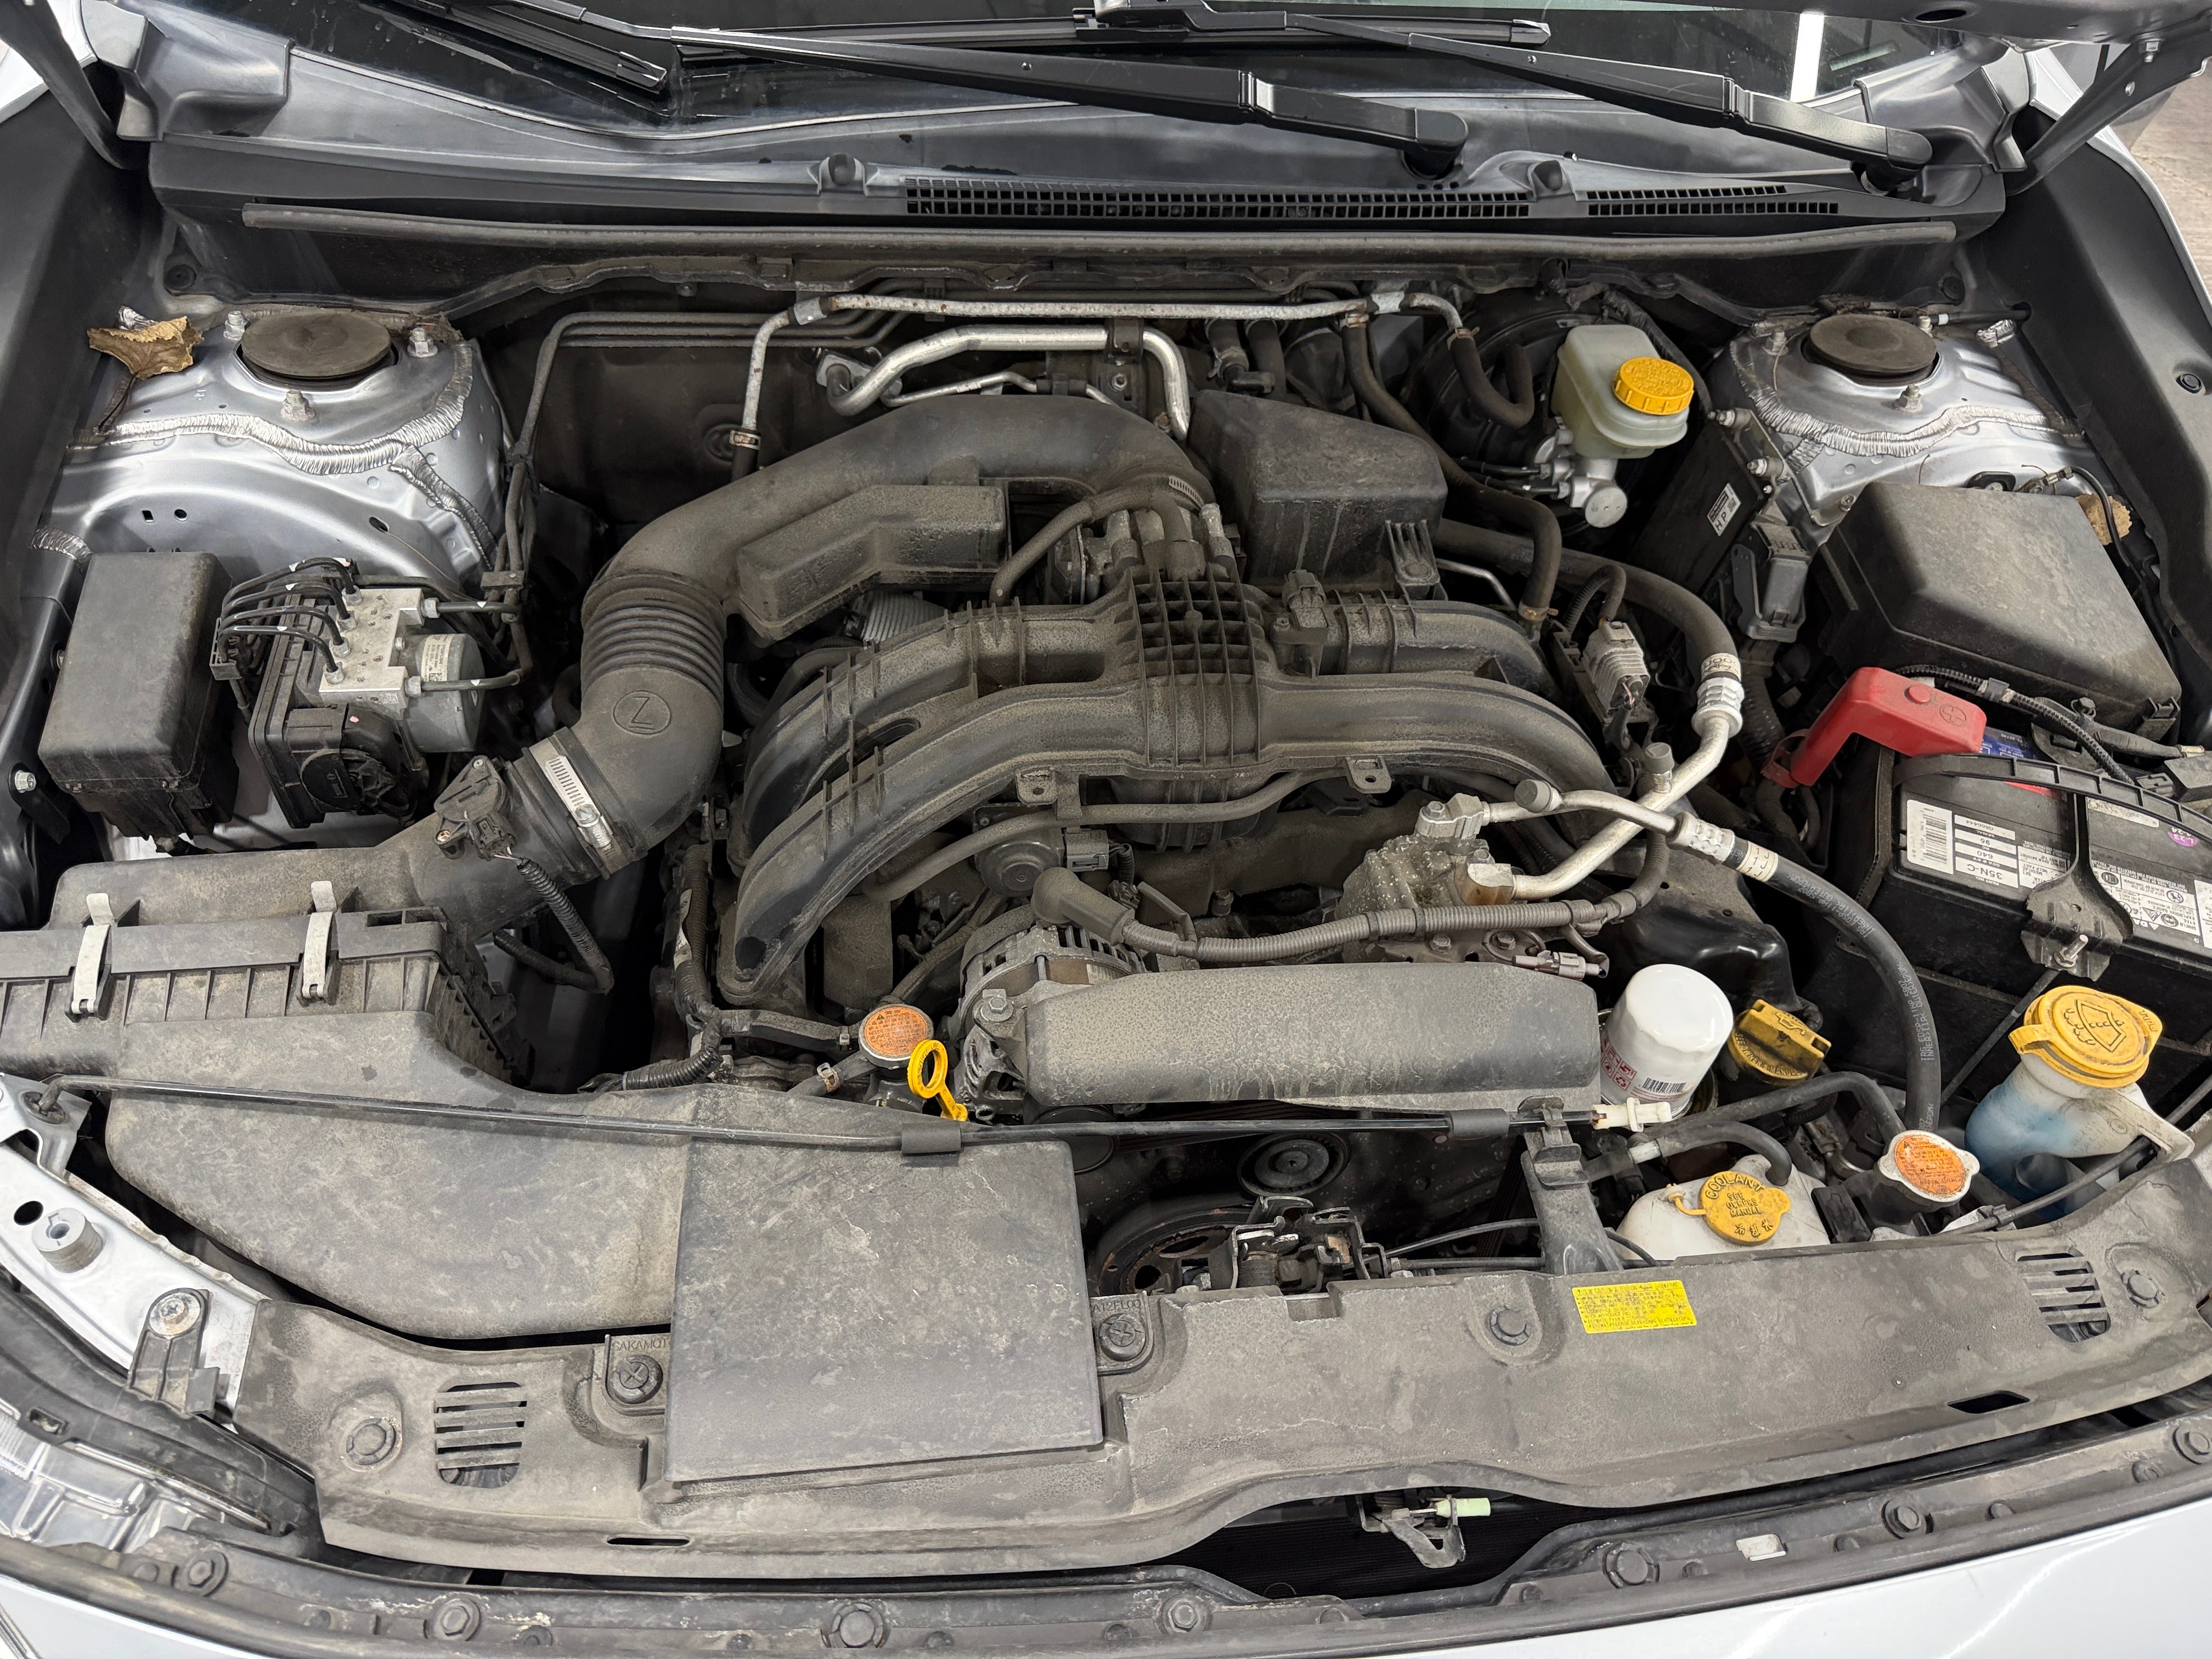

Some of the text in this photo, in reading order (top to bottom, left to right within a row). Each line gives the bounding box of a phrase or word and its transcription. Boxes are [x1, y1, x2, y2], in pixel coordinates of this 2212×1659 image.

[1977, 850, 1993, 859] 640
[1967, 864, 2002, 880] 35N-C
[1735, 1032, 1746, 1046] SEE
[1769, 1065, 1801, 1076] MANUAL
[1705, 1173, 1765, 1199] COOLANT
[1728, 1192, 1745, 1201] SEE
[1726, 1198, 1759, 1210] OWNERS
[1730, 1206, 1763, 1217] MANUAL
